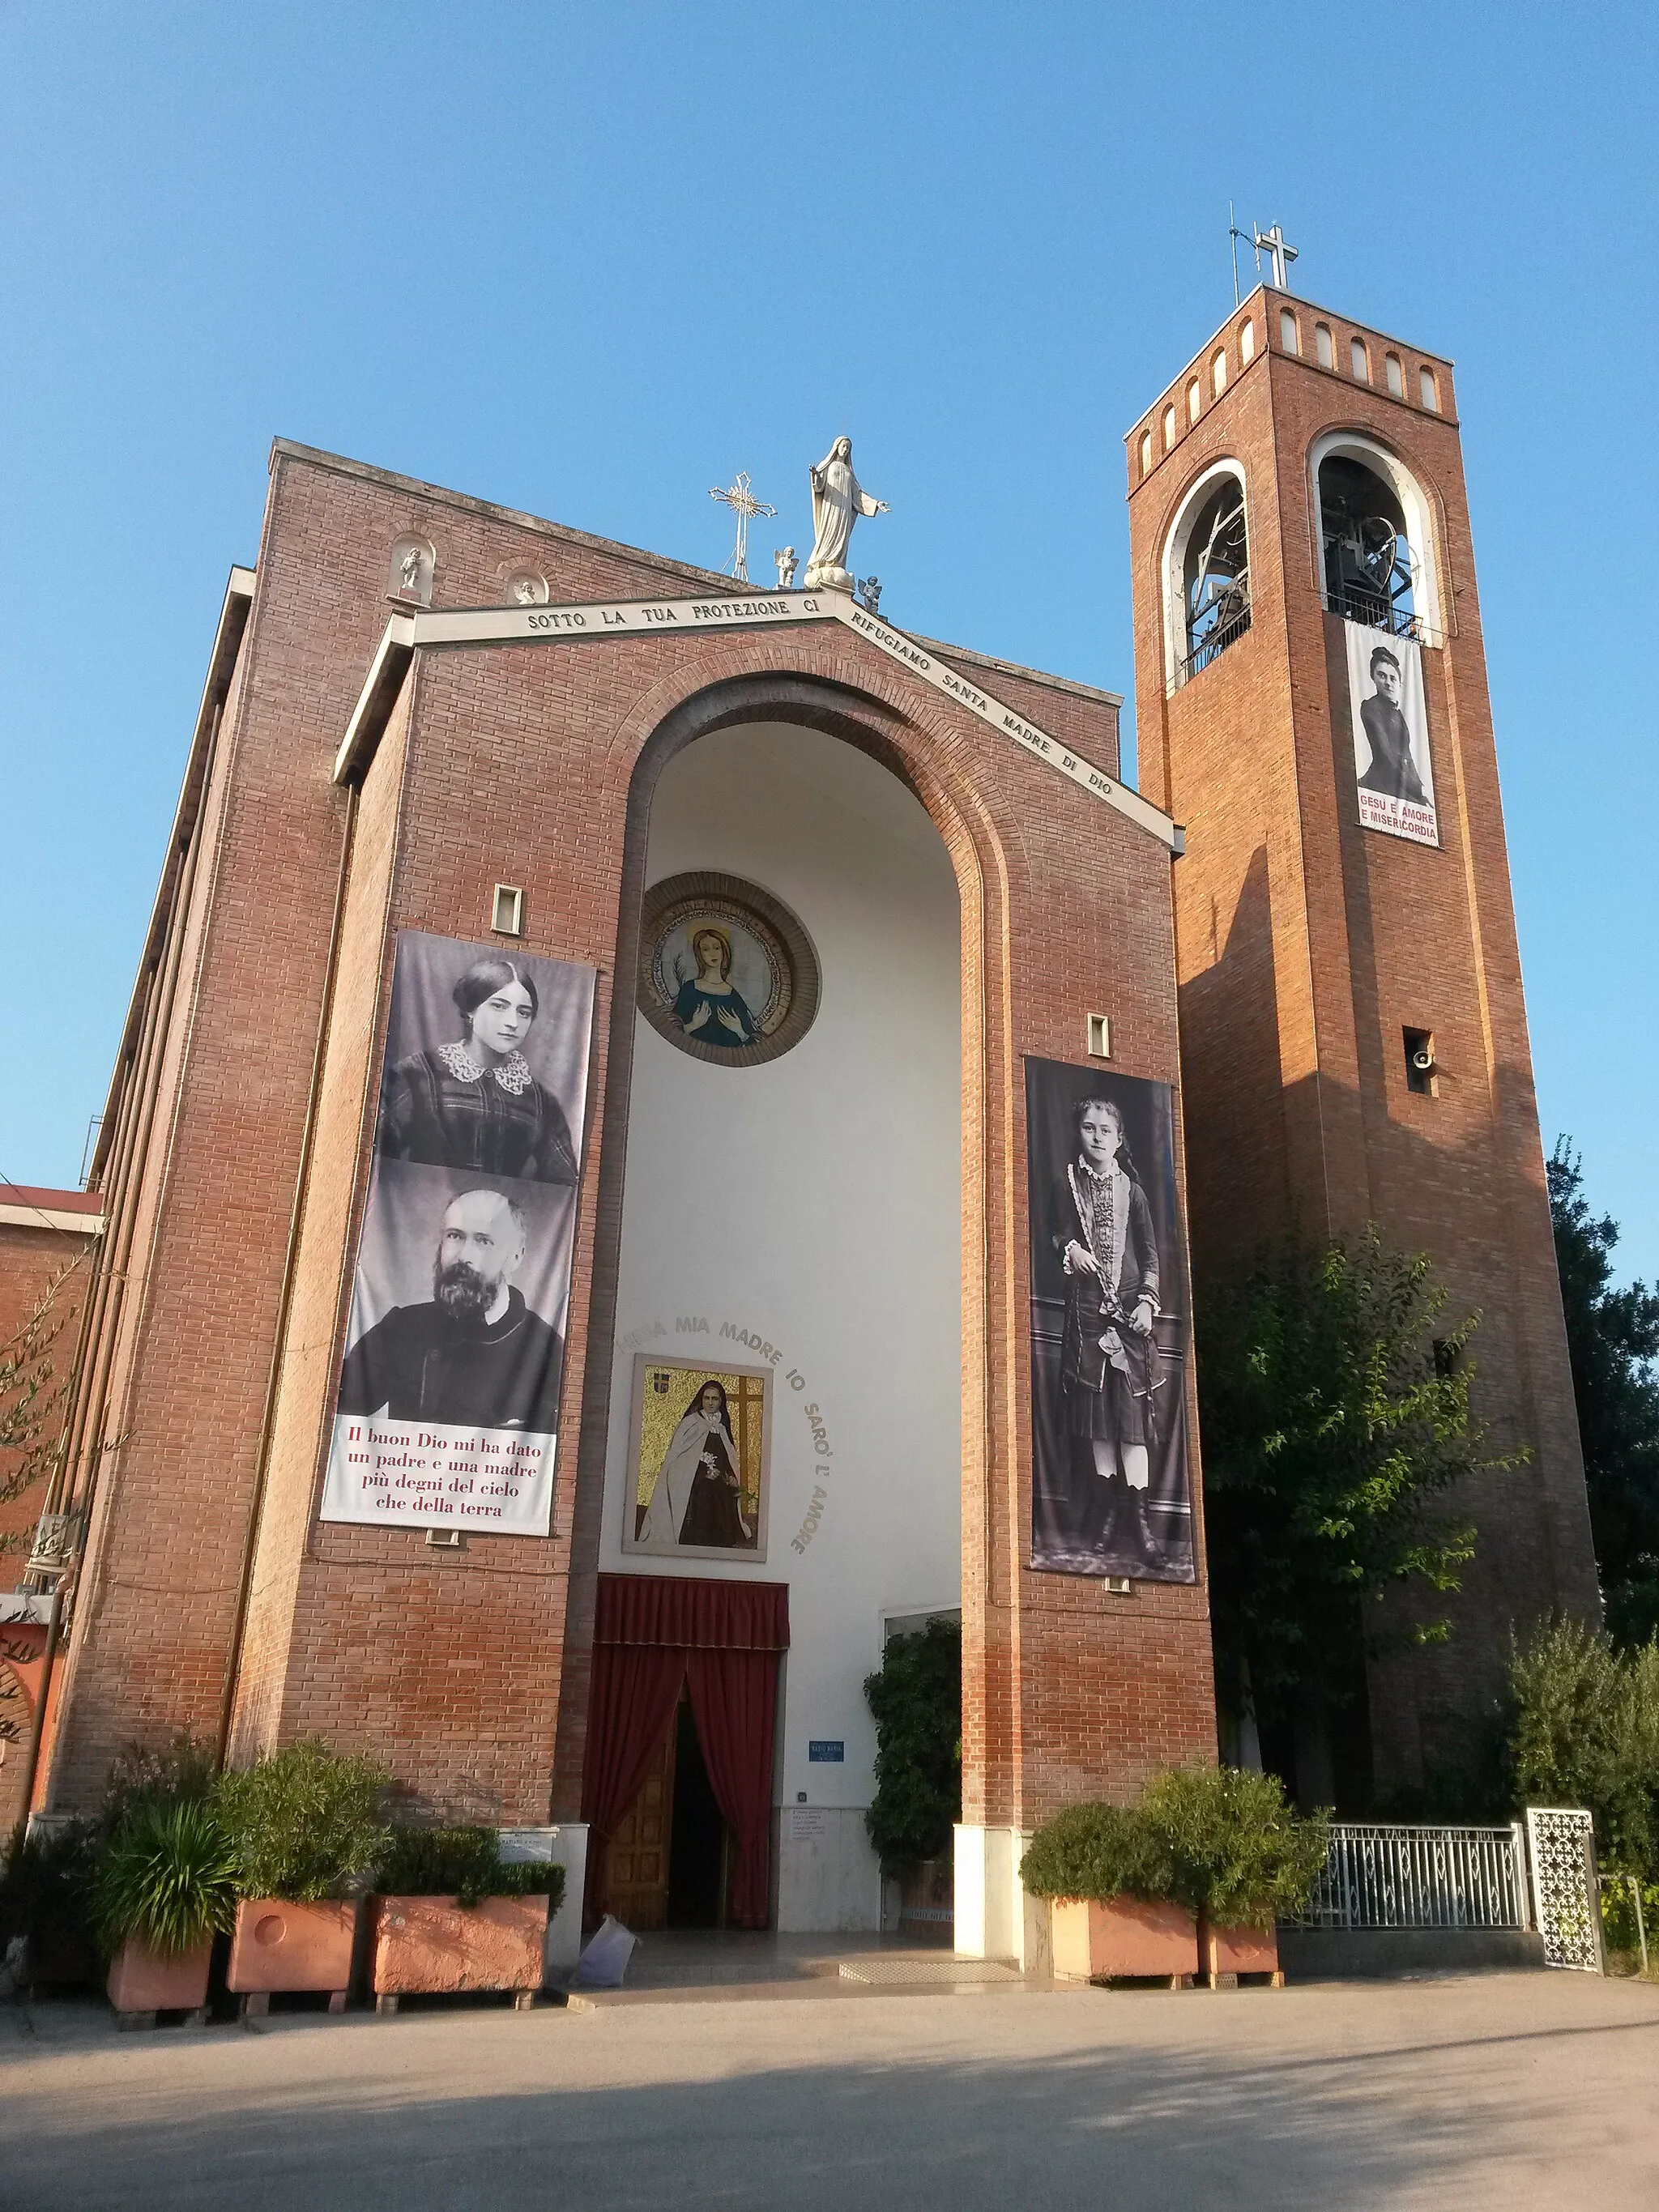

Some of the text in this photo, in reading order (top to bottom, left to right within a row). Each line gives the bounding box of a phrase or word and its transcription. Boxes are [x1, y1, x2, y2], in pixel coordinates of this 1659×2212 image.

[528, 599, 820, 628] SOTTO LA TUA PROTEZIONE CI
[851, 612, 1112, 795] RIFUGIAMO SANTA MADRE DI DIO
[1362, 809, 1436, 839] E MISERICORDIA
[1401, 807, 1434, 825] AMORE
[675, 1316, 710, 1334] MIA
[719, 1321, 783, 1366] MADRE
[785, 1368, 805, 1392] IO
[348, 1426, 541, 1458] Il buon Dio mi ha dato
[348, 1452, 537, 1478] un padre e una madre
[361, 1472, 519, 1498] più degni del cielo
[376, 1494, 502, 1517] che della terra
[791, 1485, 828, 1555] AMORE
